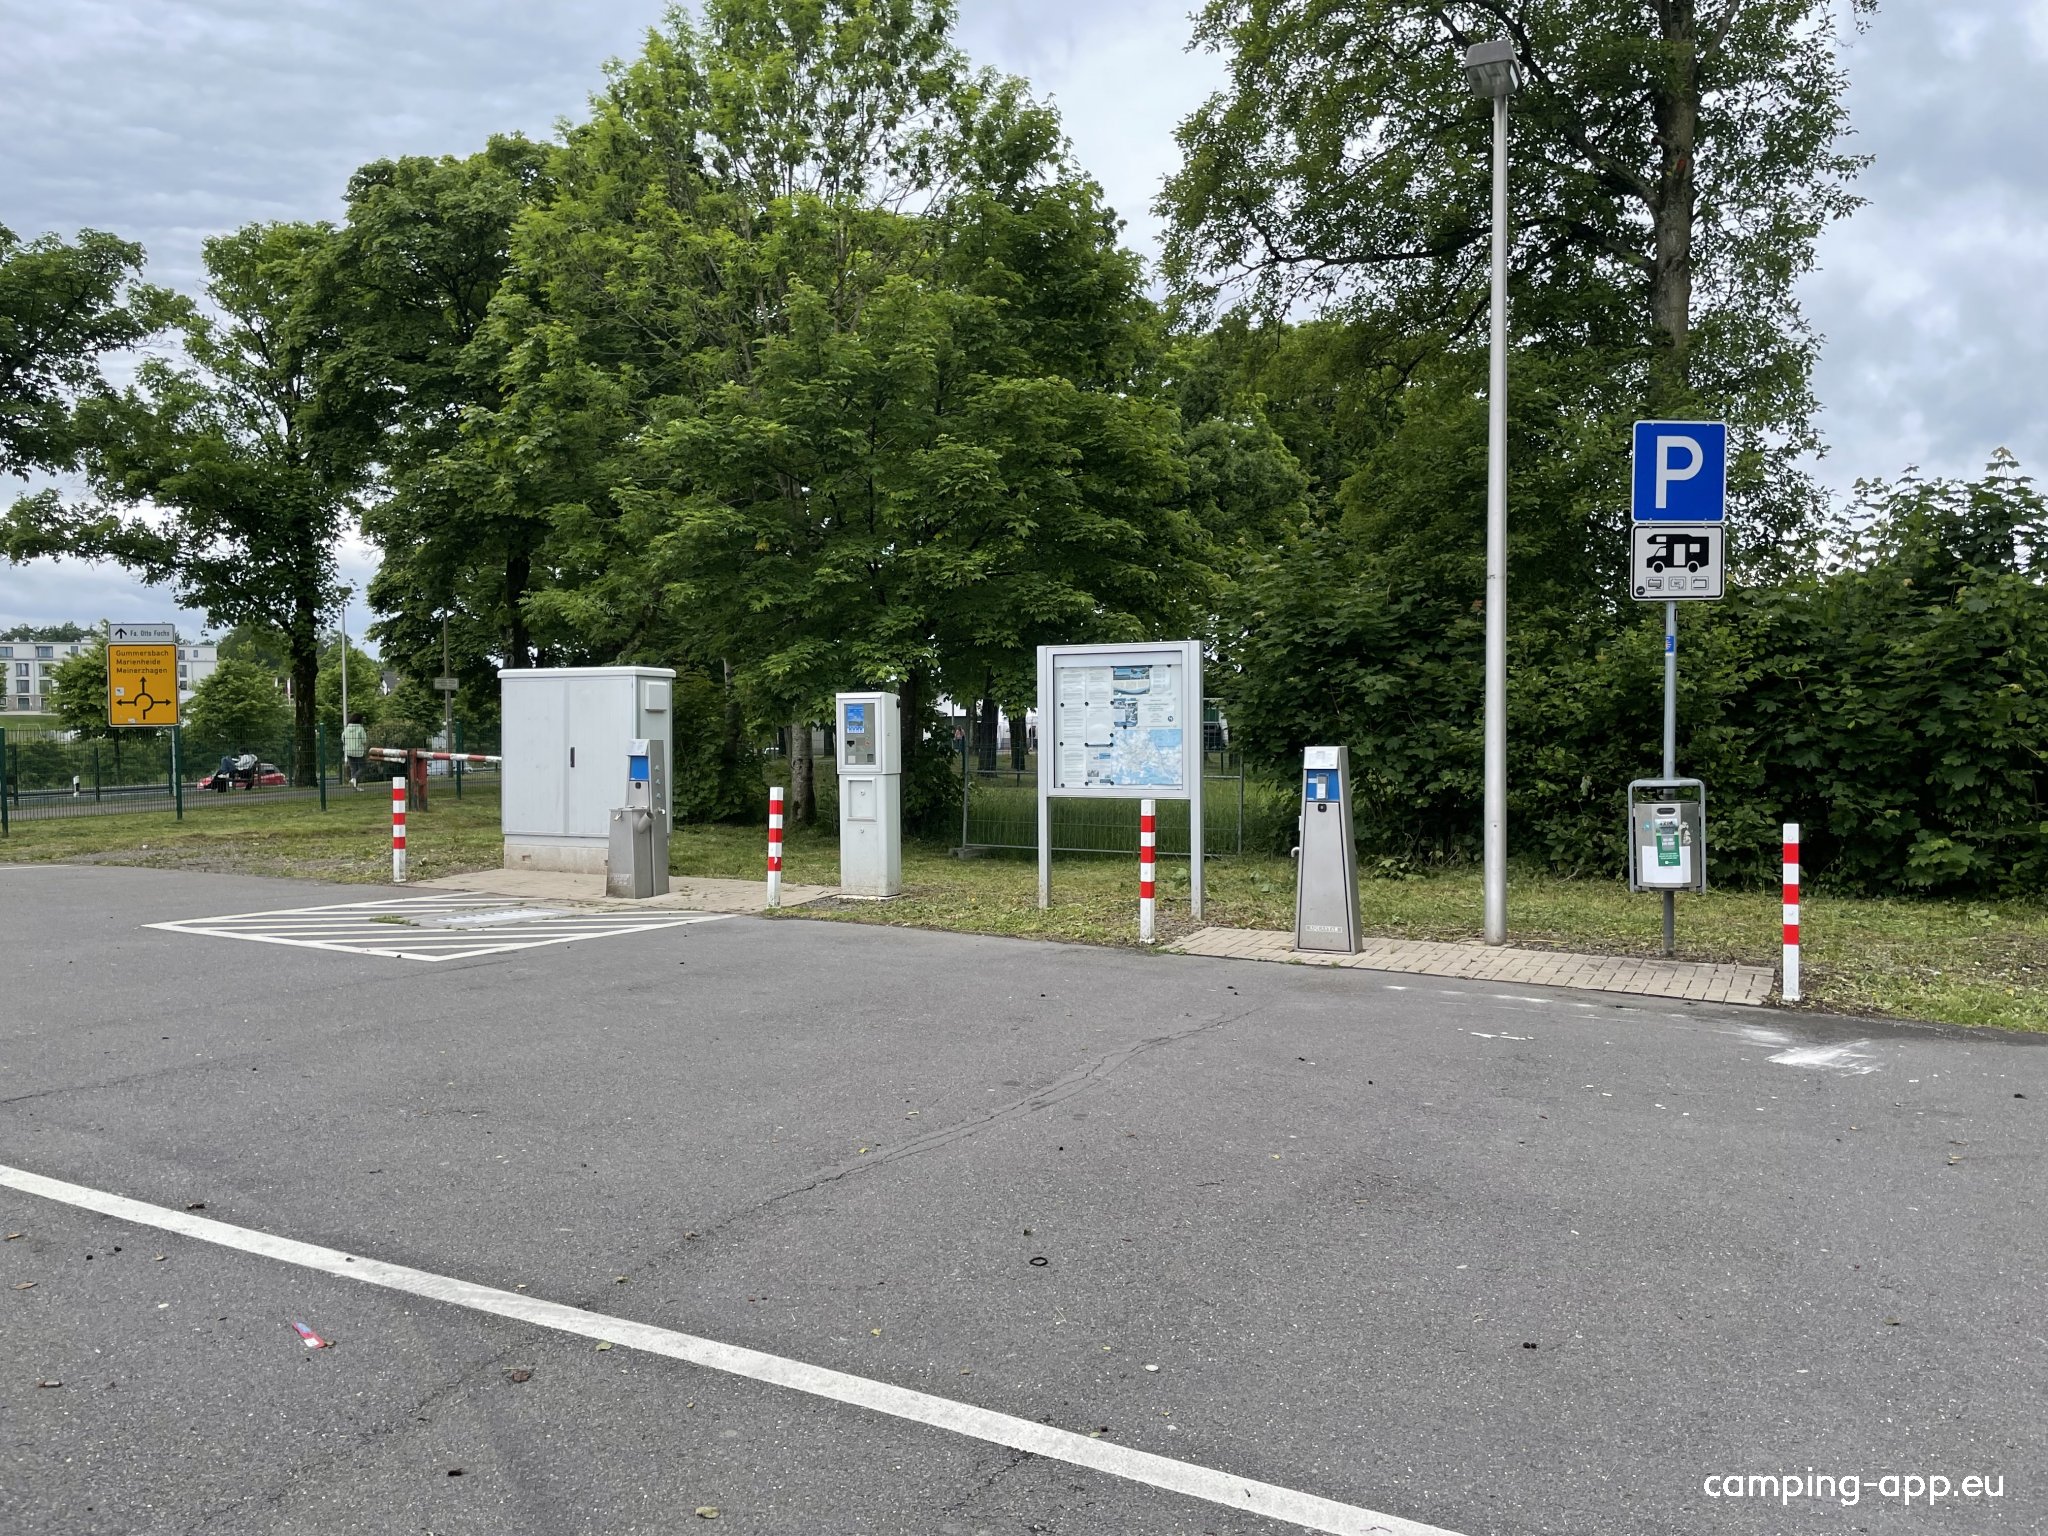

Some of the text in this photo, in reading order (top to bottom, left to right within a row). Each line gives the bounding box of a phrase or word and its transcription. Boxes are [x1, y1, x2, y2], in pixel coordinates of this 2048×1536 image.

[1655, 435, 1704, 509] P
[130, 629, 170, 637] Fa. Otto Fuchs
[116, 667, 168, 675] Meinerzhagen
